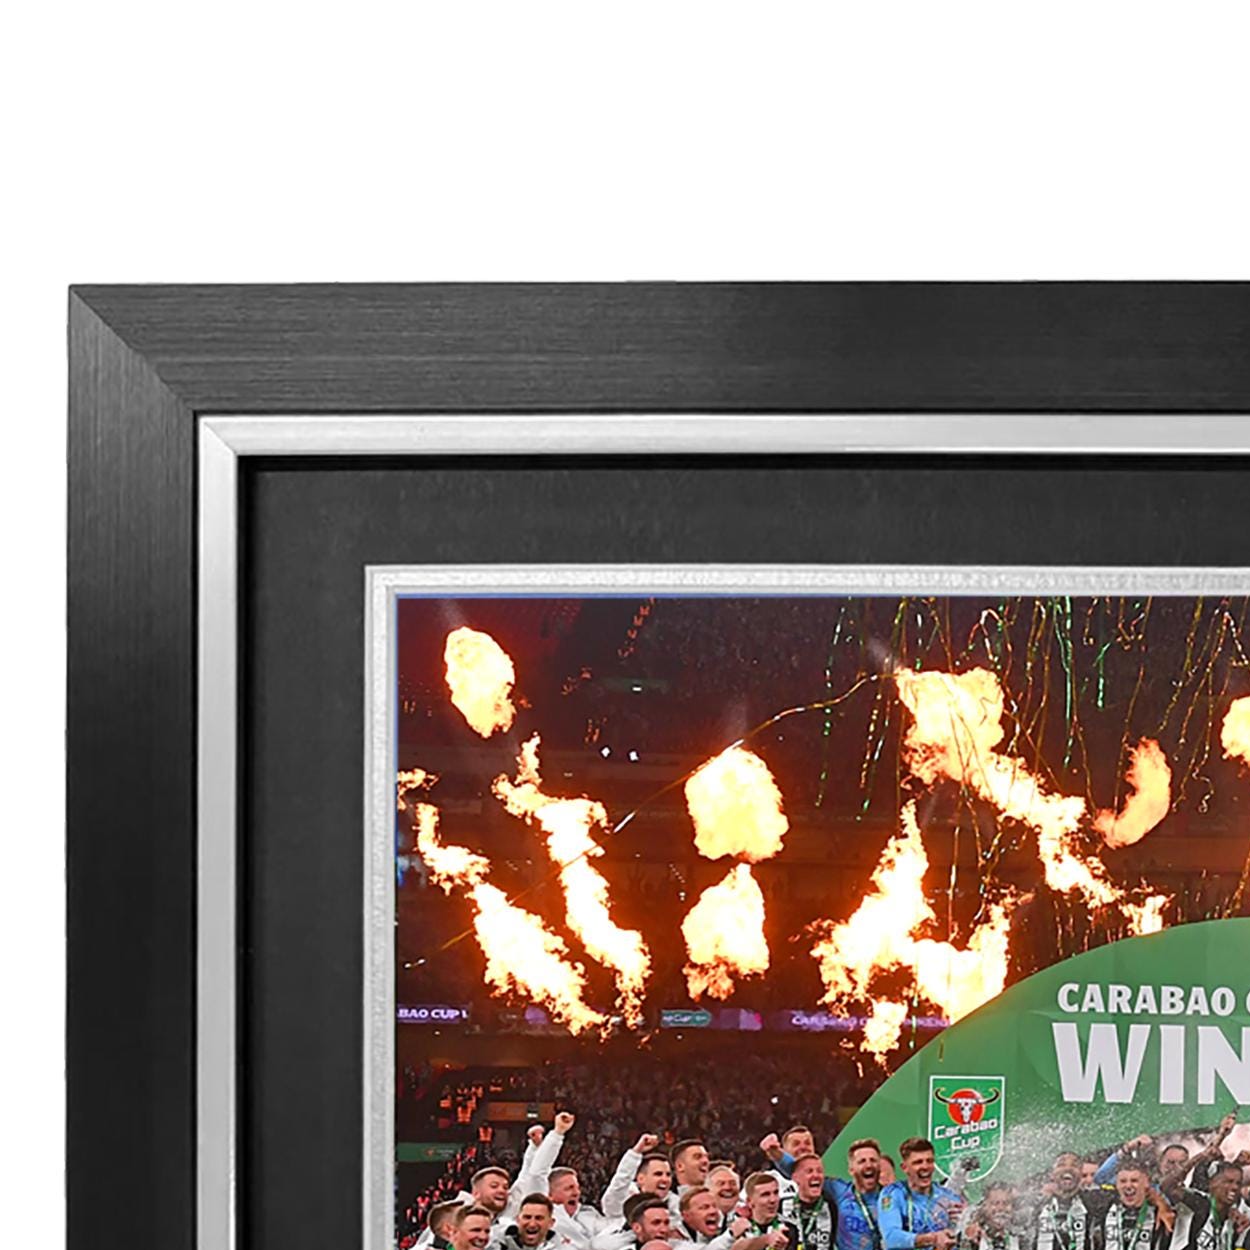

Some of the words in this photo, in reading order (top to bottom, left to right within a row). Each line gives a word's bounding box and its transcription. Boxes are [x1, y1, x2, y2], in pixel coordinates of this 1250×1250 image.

[1057, 983, 1236, 1016] CARABAO
[430, 1009, 459, 1019] CUP
[934, 1119, 998, 1139] Carabao
[951, 1136, 980, 1150] Cup
